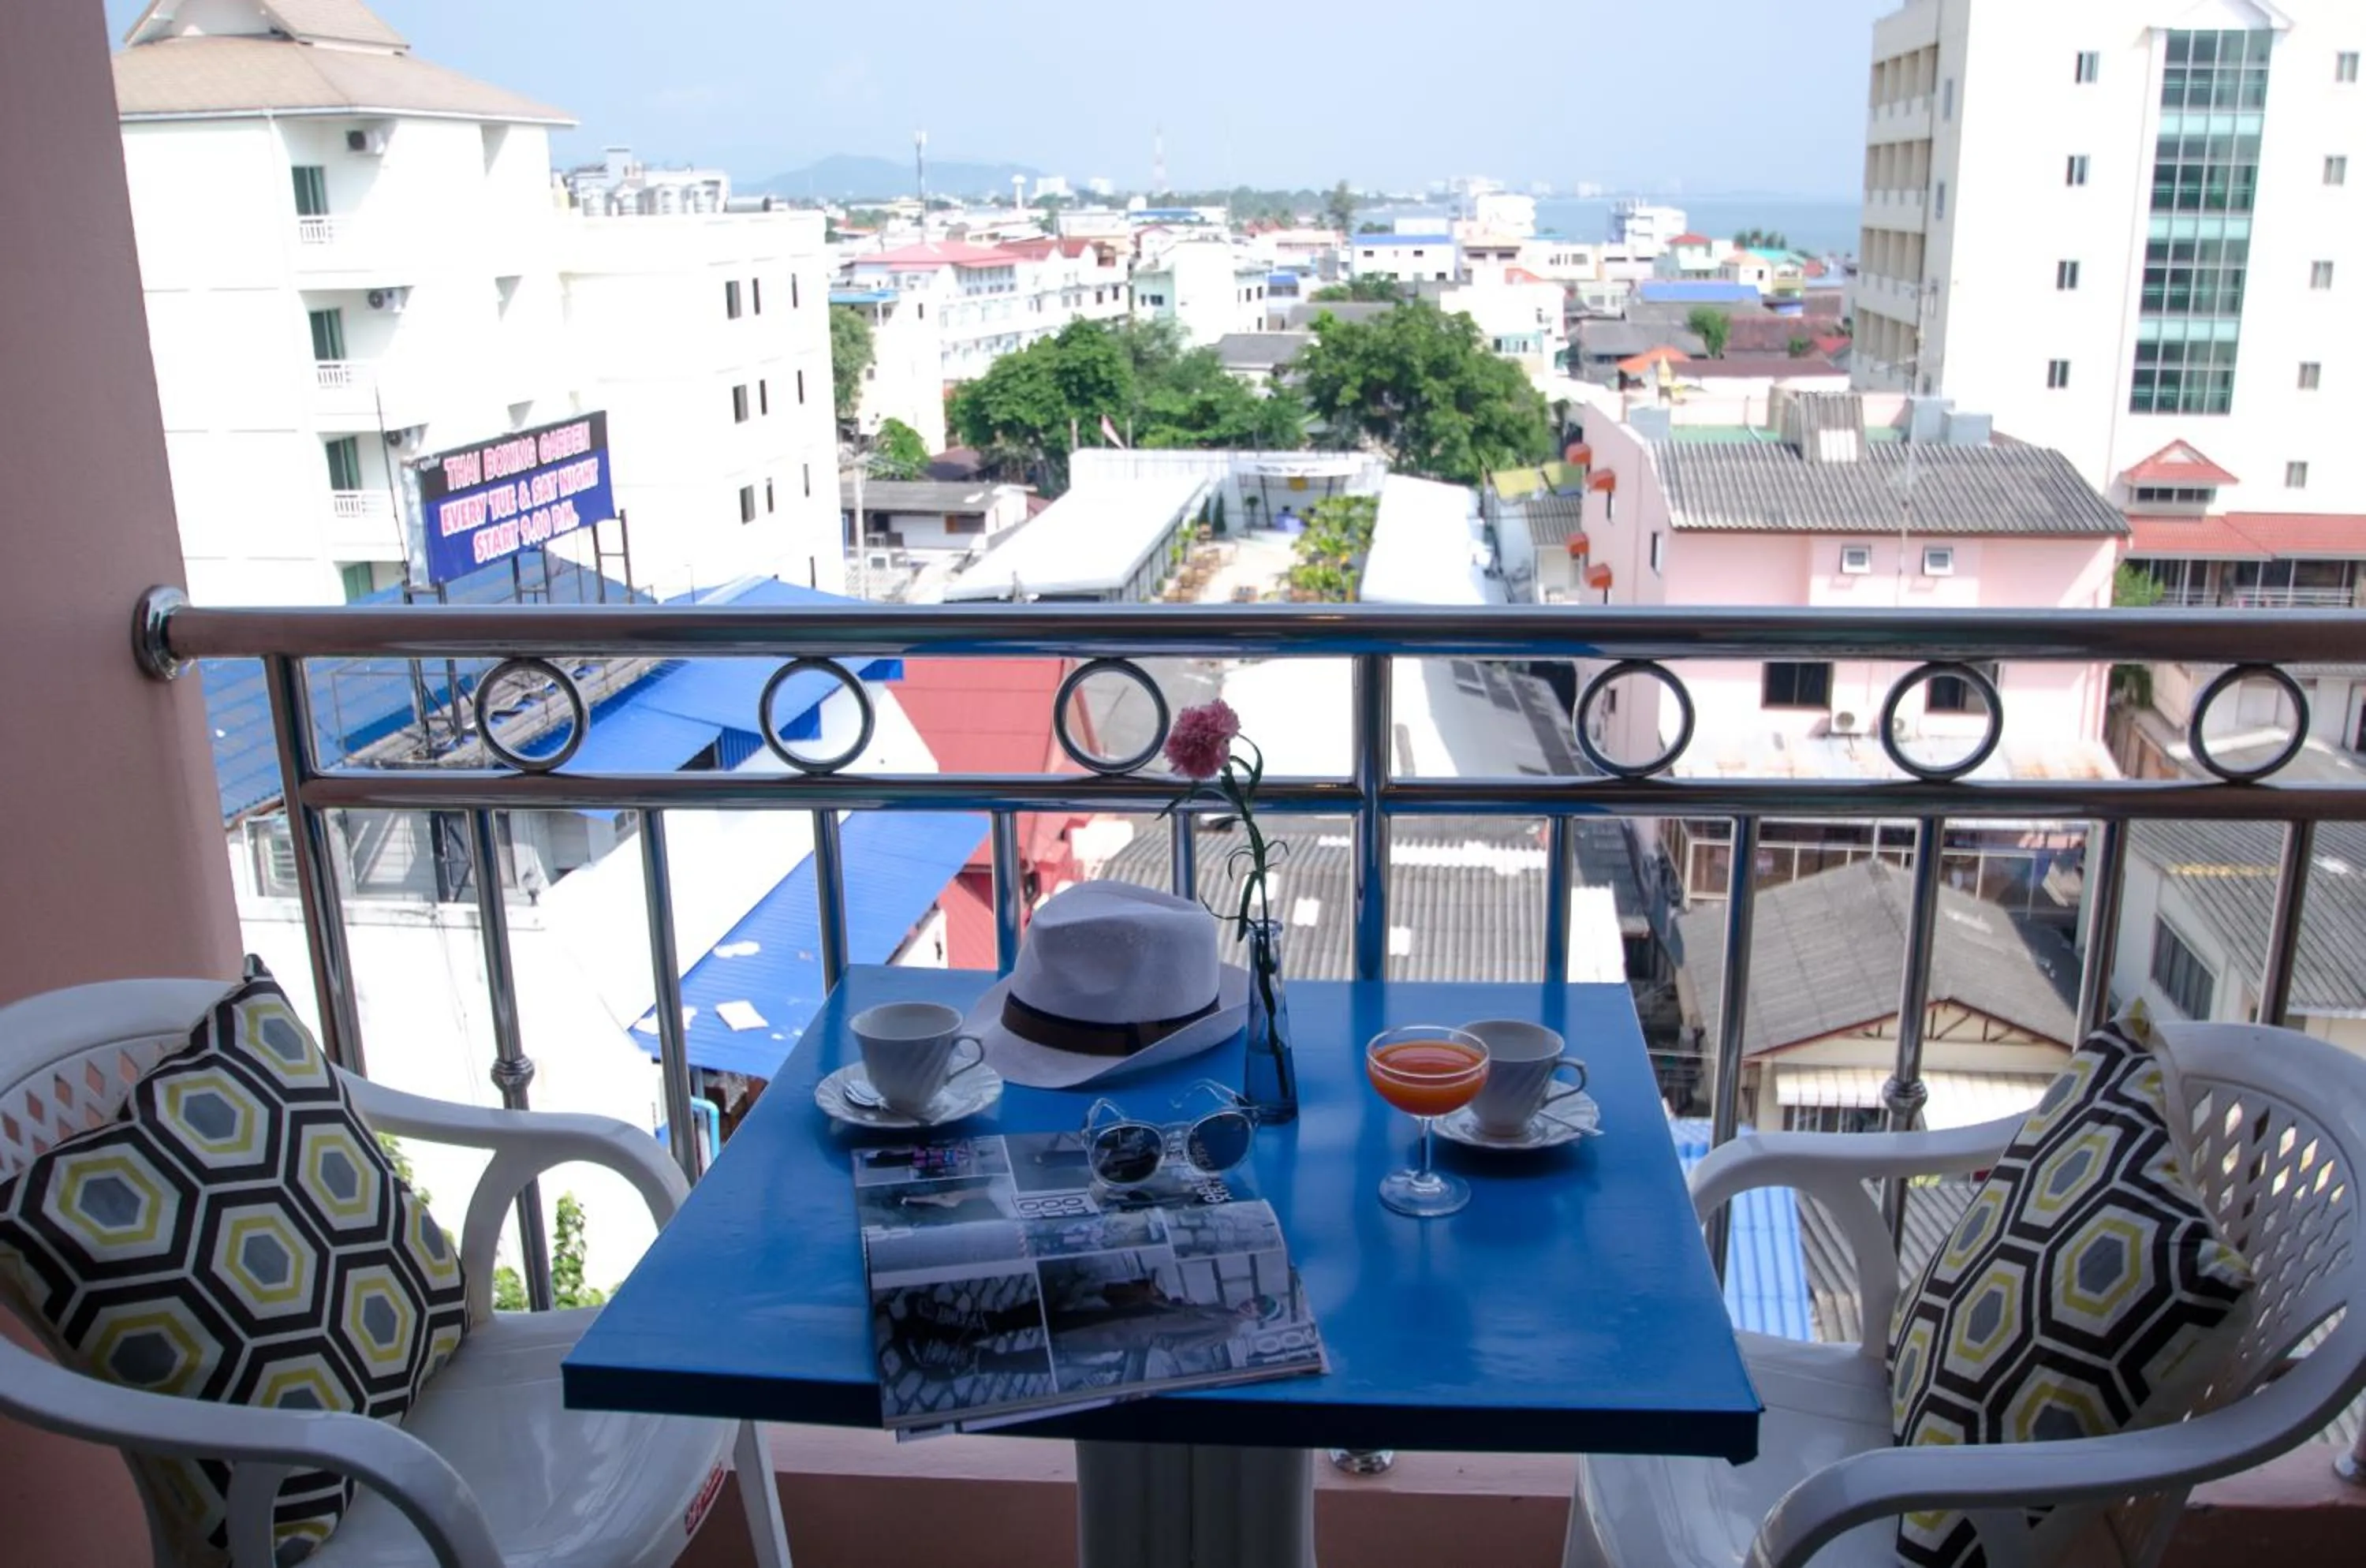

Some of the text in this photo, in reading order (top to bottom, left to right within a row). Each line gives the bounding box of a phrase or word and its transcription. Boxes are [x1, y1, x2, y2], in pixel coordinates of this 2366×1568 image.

[443, 451, 481, 491] THAI
[440, 457, 598, 536] EVERY TUE & SAT NIGHT
[473, 517, 520, 564] START
